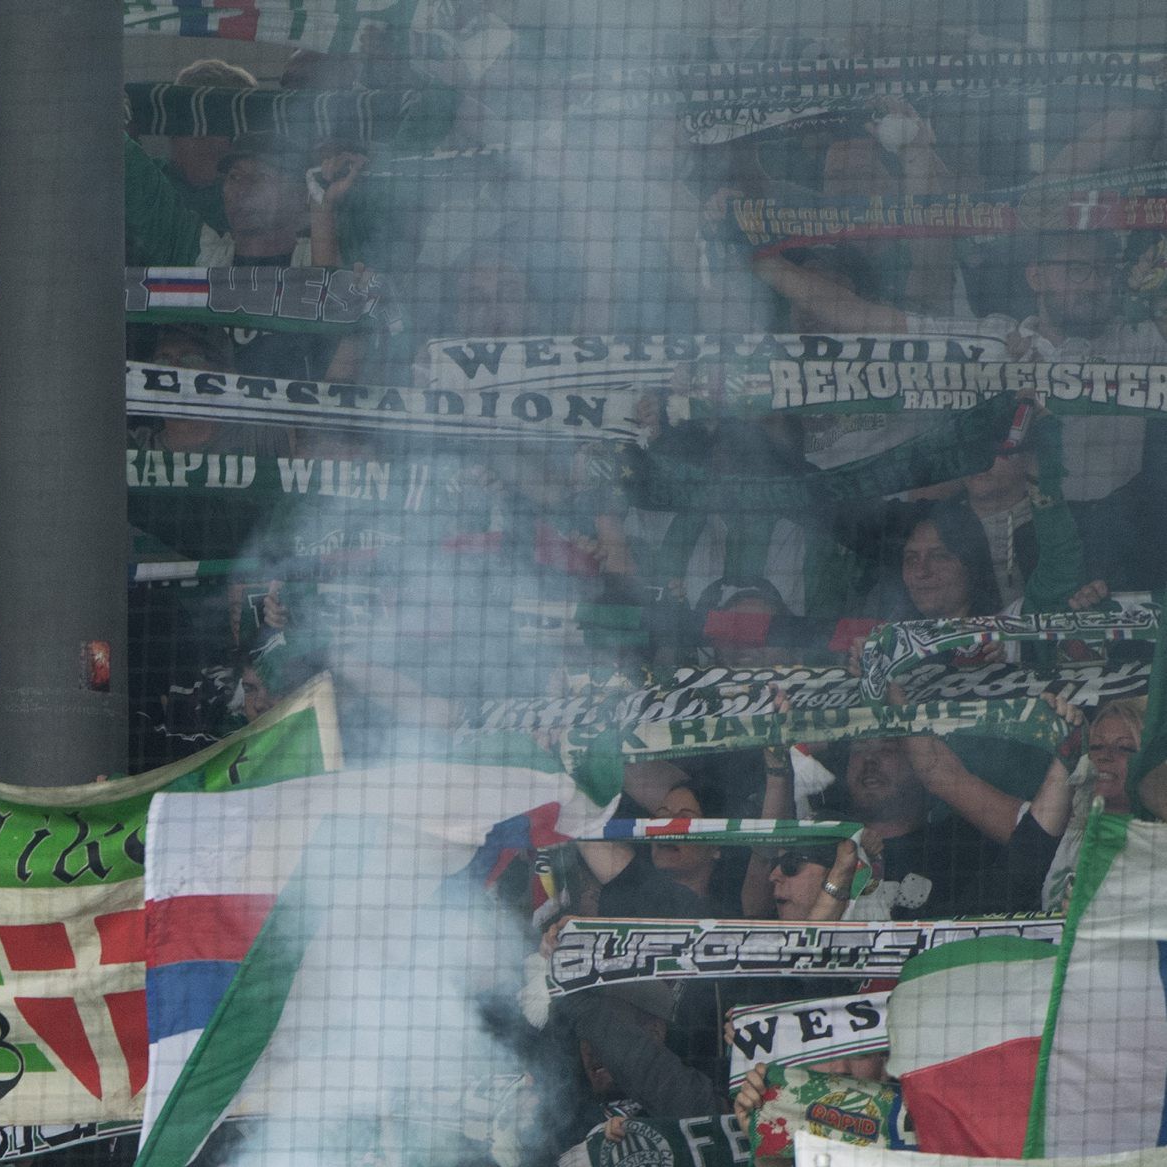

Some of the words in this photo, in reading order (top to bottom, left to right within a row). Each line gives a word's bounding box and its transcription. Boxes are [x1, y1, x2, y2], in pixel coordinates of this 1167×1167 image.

[125, 364, 607, 428] ESTSTADION
[903, 389, 977, 411] RAPID
[276, 457, 391, 501] WIEN
[812, 1103, 876, 1135] RAPID
